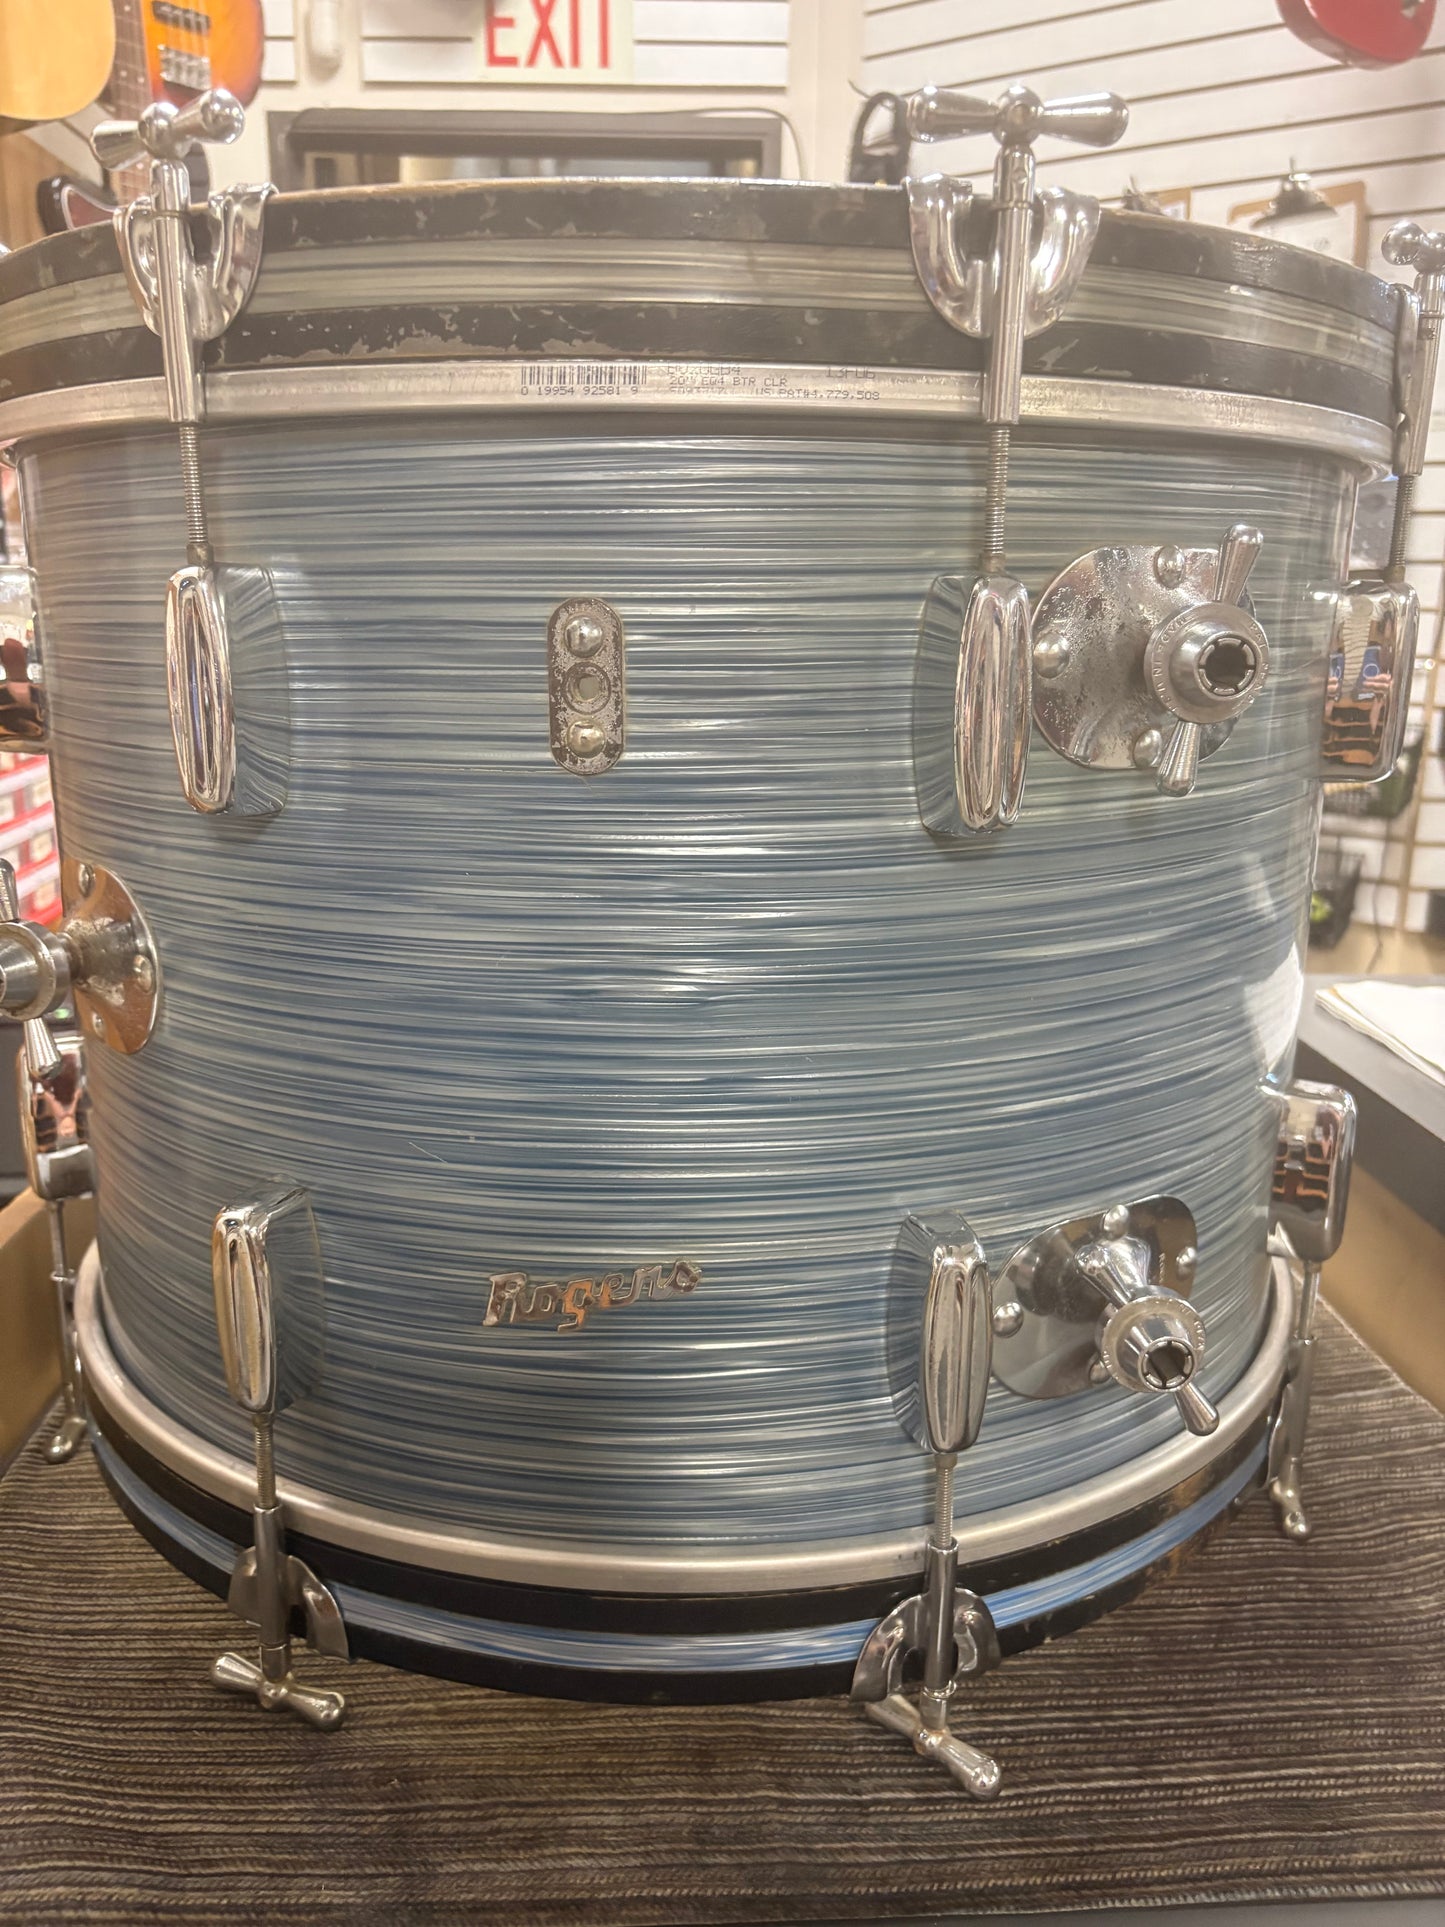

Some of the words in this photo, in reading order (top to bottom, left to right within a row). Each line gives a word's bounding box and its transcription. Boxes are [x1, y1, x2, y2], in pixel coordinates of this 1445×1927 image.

[485, 0, 610, 68] EXIT
[520, 386, 529, 396] 0
[537, 386, 575, 396] 19954
[583, 386, 621, 396] 92581
[630, 386, 639, 396] 9
[701, 376, 725, 386] EQ4
[732, 377, 756, 387] BTR
[763, 377, 788, 388] CLR
[483, 1256, 703, 1334] Rogers
